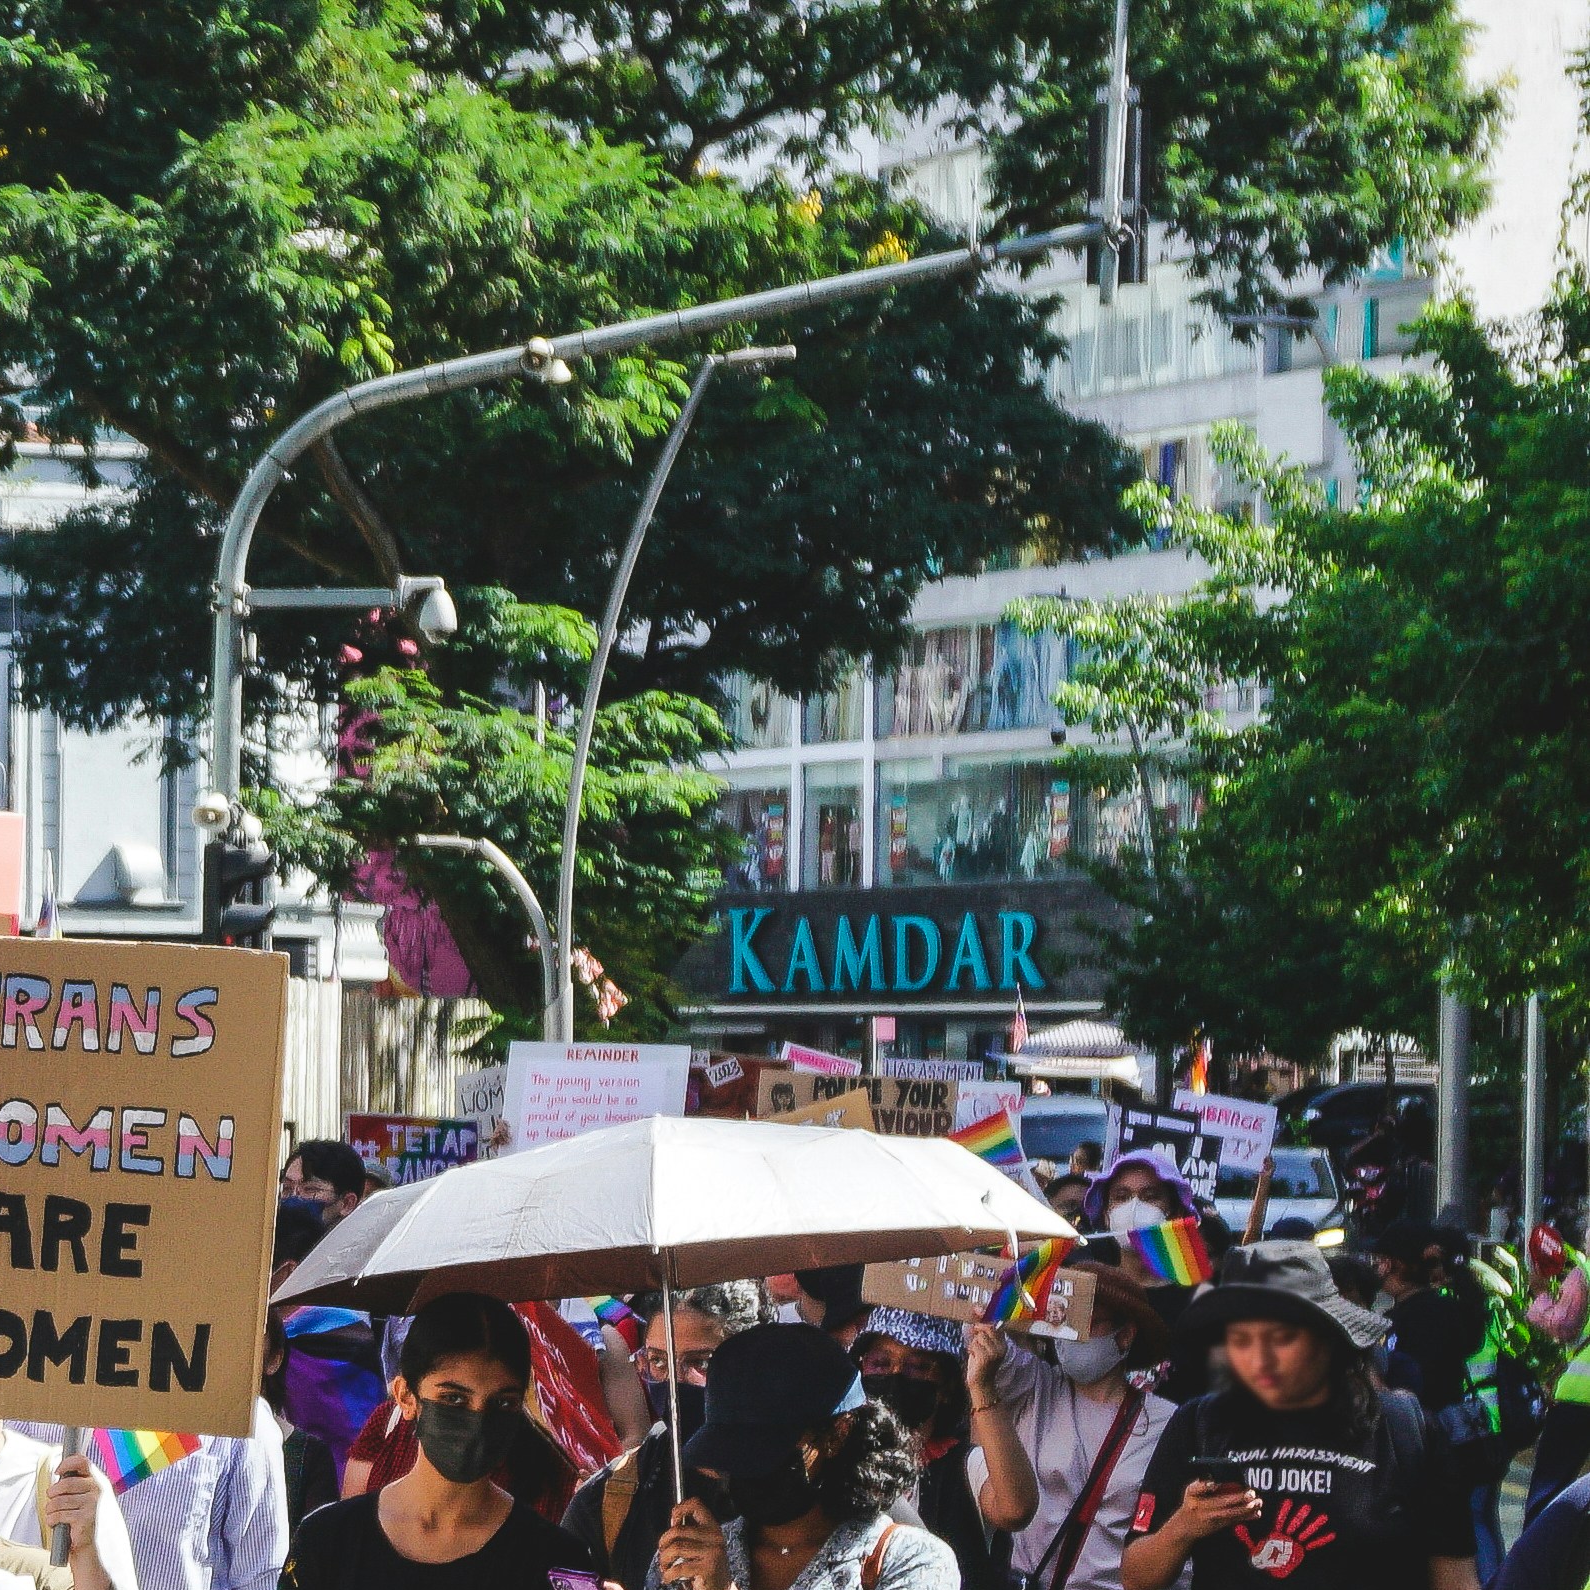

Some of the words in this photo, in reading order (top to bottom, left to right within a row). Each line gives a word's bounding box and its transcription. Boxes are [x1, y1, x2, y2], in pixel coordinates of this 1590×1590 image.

[728, 907, 1047, 994] KAMDAR
[565, 1048, 640, 1063] REMINDER
[530, 1072, 551, 1086] The
[556, 1076, 591, 1091] young
[598, 1075, 641, 1089] version
[885, 1057, 983, 1082] HARASSMENT
[529, 1093, 543, 1104] of
[547, 1095, 567, 1109] you
[571, 1093, 603, 1105] would
[606, 1094, 620, 1105] be
[624, 1096, 638, 1106] so
[896, 1080, 950, 1110] YOUR
[526, 1110, 560, 1126] proud
[564, 1110, 577, 1121] of
[580, 1113, 600, 1128] you
[386, 1124, 477, 1157] TETAP
[526, 1130, 540, 1141] up
[1271, 1446, 1377, 1475] HARASSMENT
[1247, 1467, 1273, 1491] NO
[1277, 1469, 1333, 1494] JOKE!
